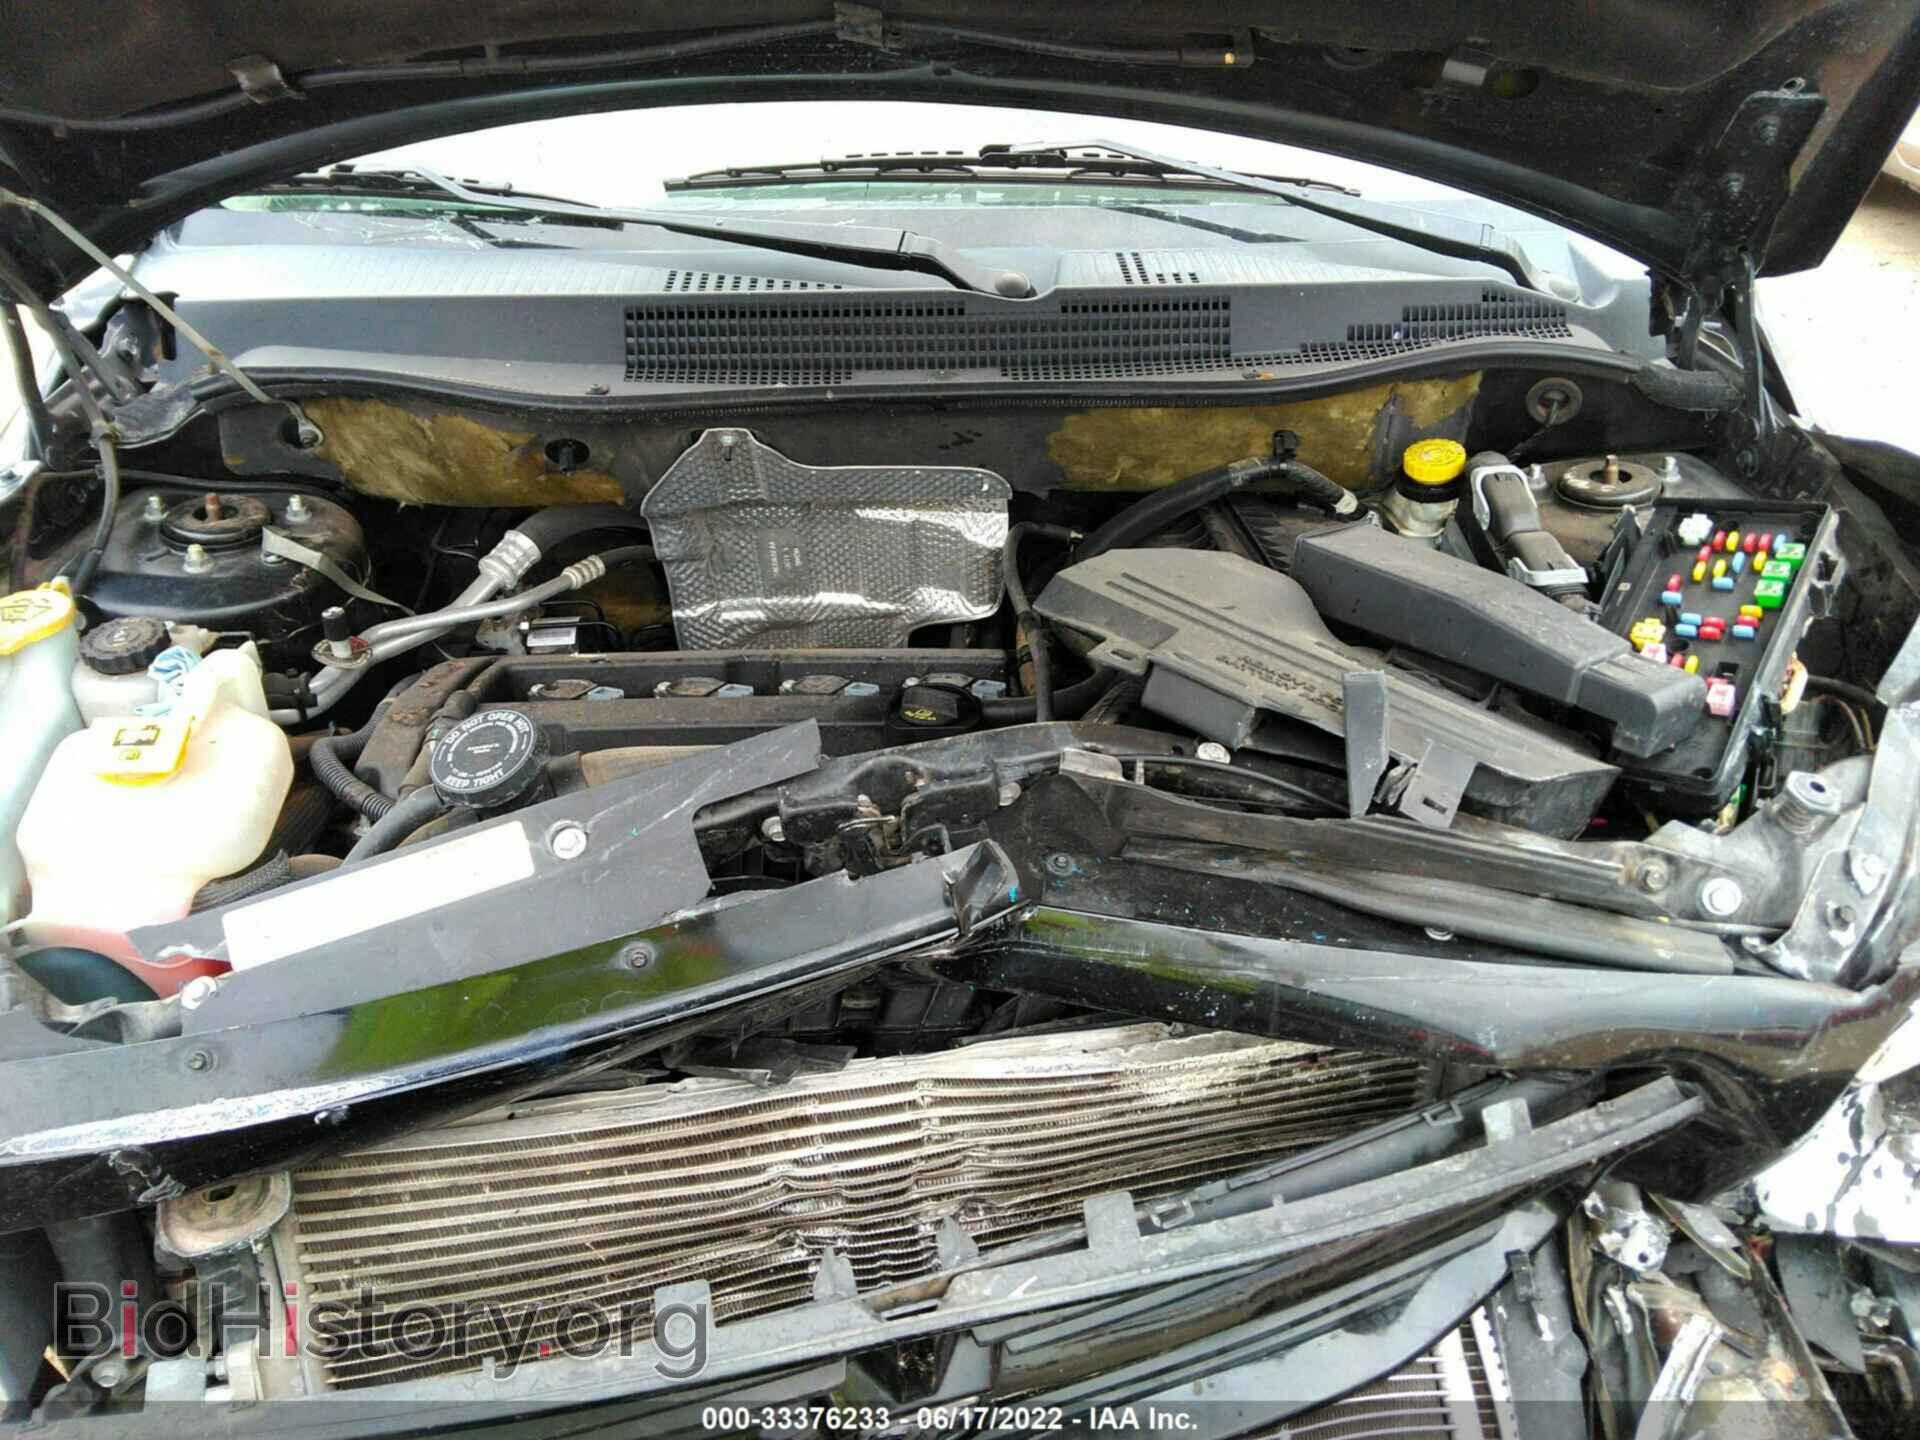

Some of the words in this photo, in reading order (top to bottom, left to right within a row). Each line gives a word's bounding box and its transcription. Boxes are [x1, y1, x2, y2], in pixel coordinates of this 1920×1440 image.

[445, 730, 460, 744] DO
[461, 715, 485, 730] NOT
[487, 712, 516, 722] OPEN
[443, 775, 470, 788] KEEP
[473, 768, 504, 787] TIGHT
